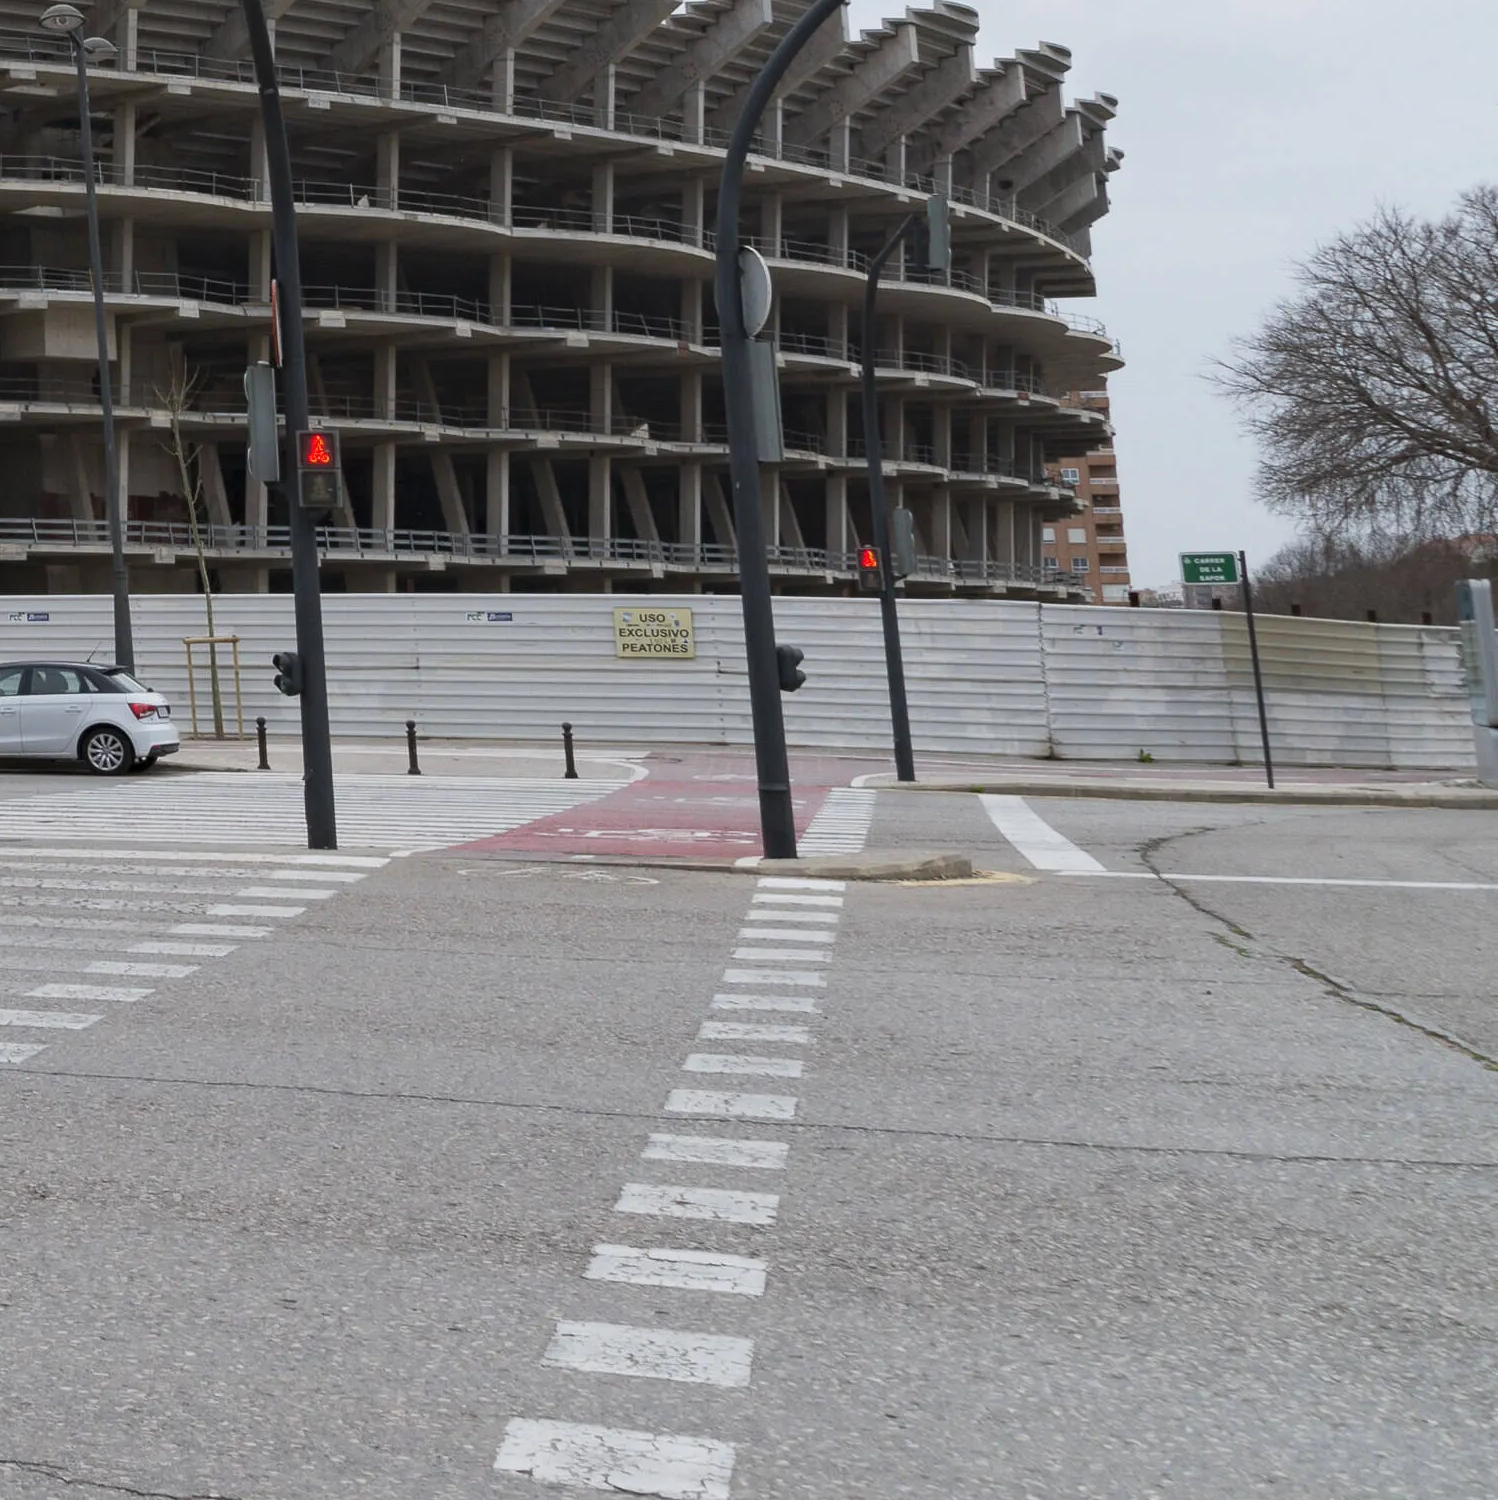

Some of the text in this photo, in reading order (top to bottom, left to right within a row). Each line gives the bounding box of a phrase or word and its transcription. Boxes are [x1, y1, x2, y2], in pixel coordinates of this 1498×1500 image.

[639, 613, 666, 623] USO
[619, 628, 689, 638] EXCLUSIVO
[622, 643, 689, 653] PEATONES
